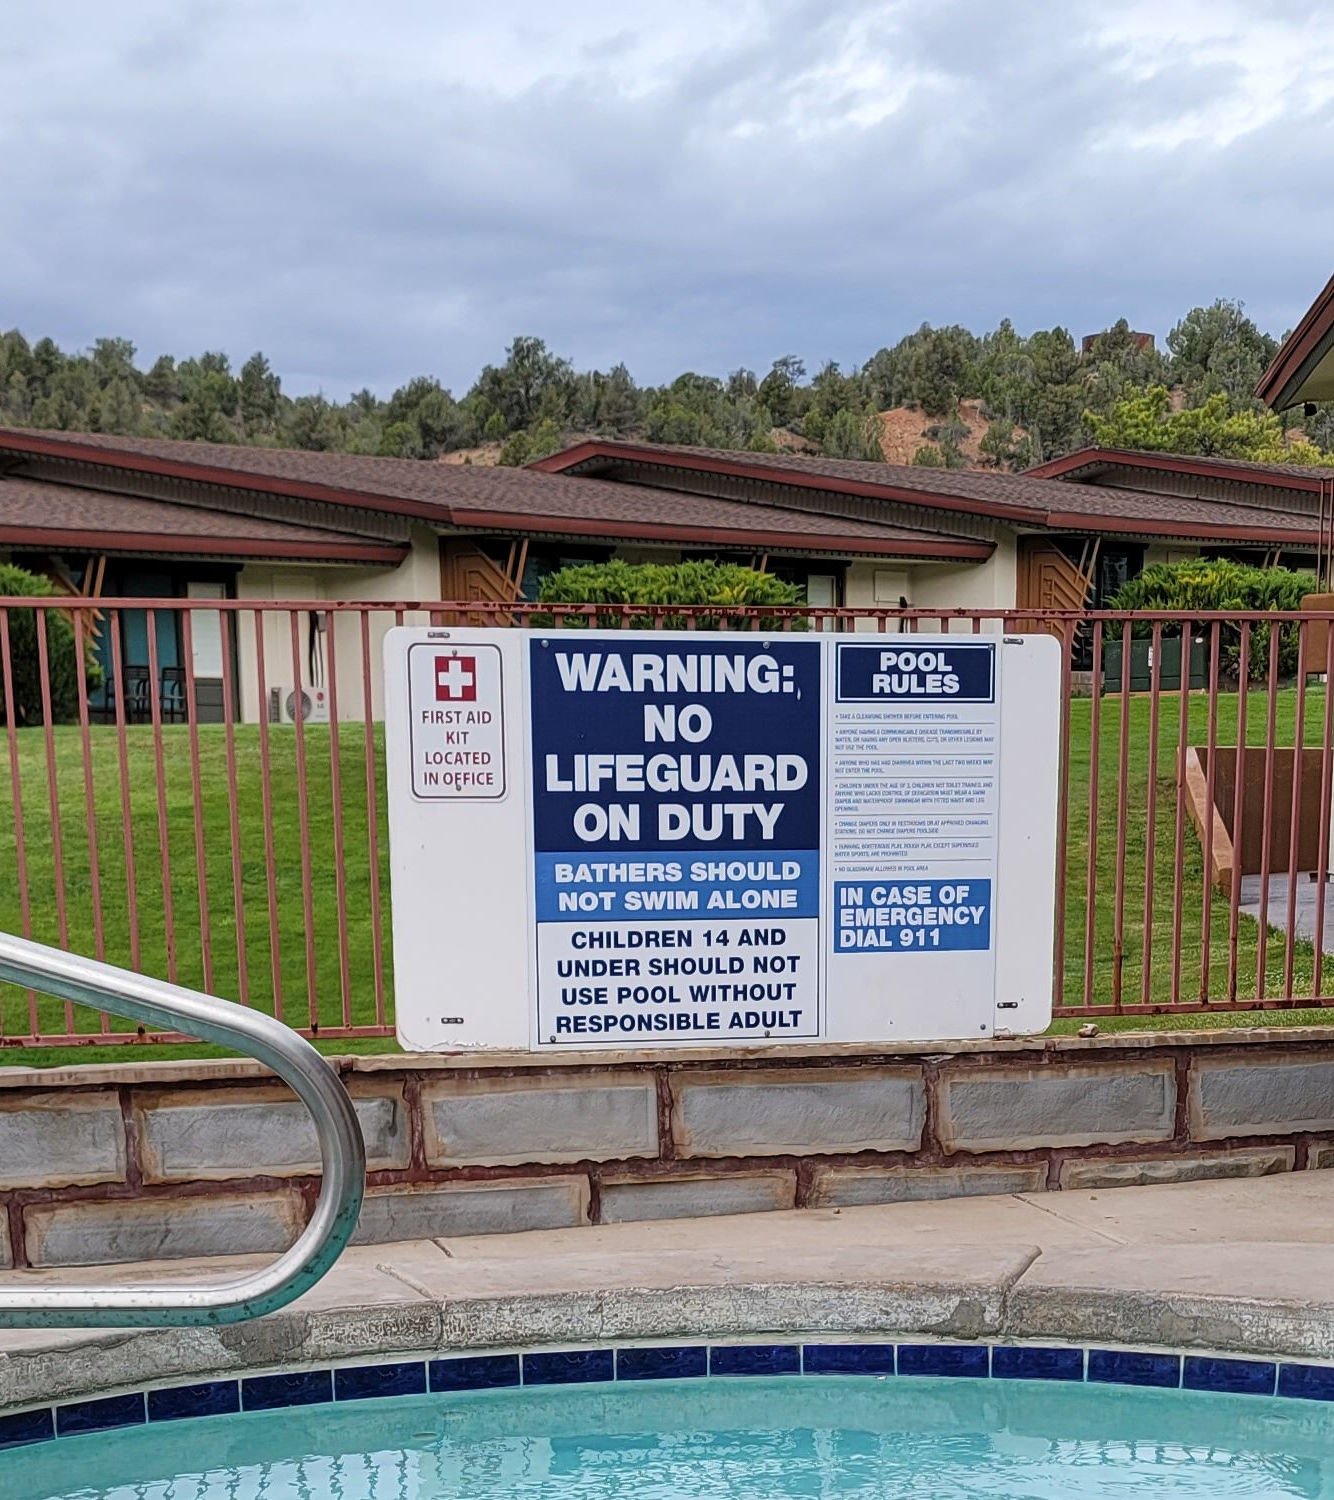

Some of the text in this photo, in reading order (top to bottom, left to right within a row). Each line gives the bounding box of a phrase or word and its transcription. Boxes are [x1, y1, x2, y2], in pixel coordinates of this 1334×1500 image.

[880, 652, 952, 672] POOL
[555, 653, 795, 693] WARNING:
[873, 674, 960, 694] RULES
[422, 711, 491, 724] FIRST AID
[644, 704, 712, 743] NO
[446, 731, 470, 745] KIT
[425, 752, 491, 765] LOCATED
[424, 772, 494, 786] IN OFFICE
[546, 754, 808, 792] LIFEGUARD
[573, 803, 785, 841] ON DUTY
[554, 861, 802, 884] BATHERS SHOULD
[558, 890, 798, 911] NOT SWIM ALONE
[840, 885, 970, 906] IN CASE OF
[840, 906, 985, 927] EMERGENCY
[571, 928, 786, 949] CHILDREN 14 AND
[840, 928, 939, 947] DIAL 911
[557, 956, 801, 978] UNDER SHOULD NOT
[561, 983, 797, 1006] USE POOL WITHOUT
[555, 1010, 803, 1034] RESPONSIBLE ADULT
